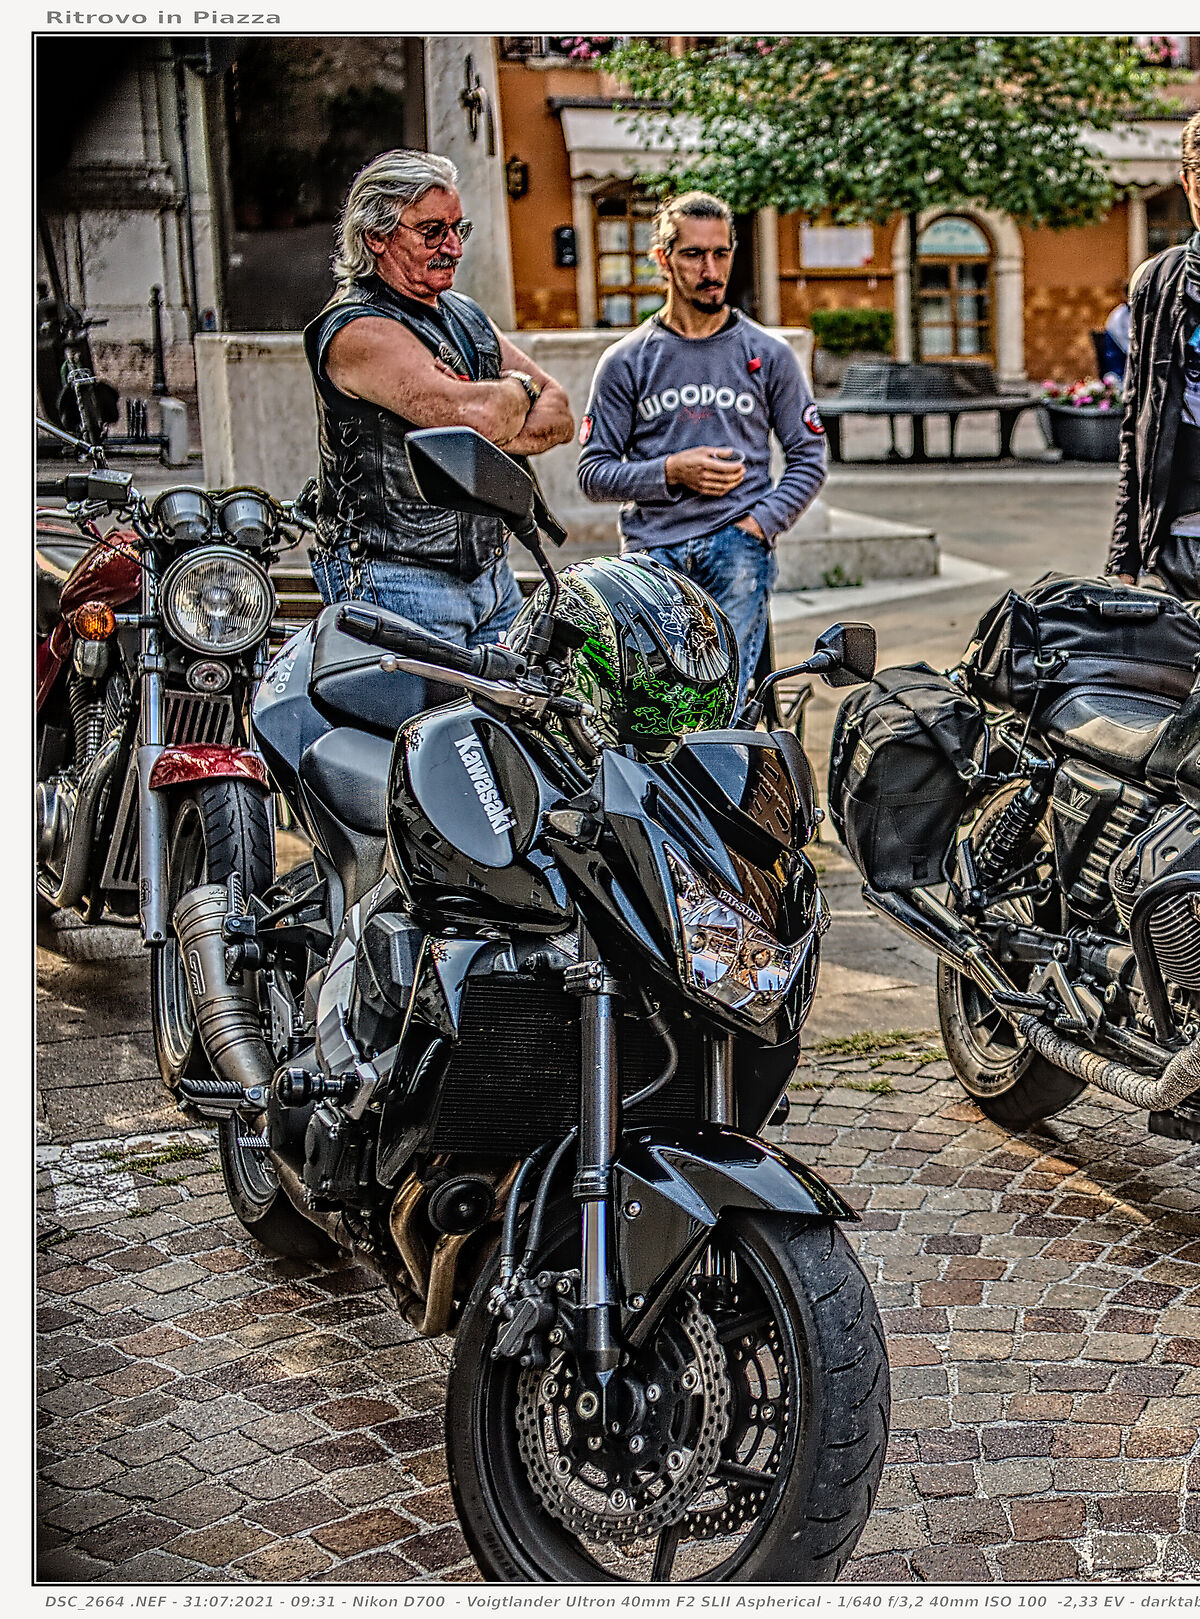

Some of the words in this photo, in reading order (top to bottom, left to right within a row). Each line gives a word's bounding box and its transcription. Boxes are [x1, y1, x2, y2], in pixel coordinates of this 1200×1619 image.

[638, 384, 755, 421] WOODOO
[453, 732, 519, 836] Kawasaki
[1069, 787, 1092, 810] V7
